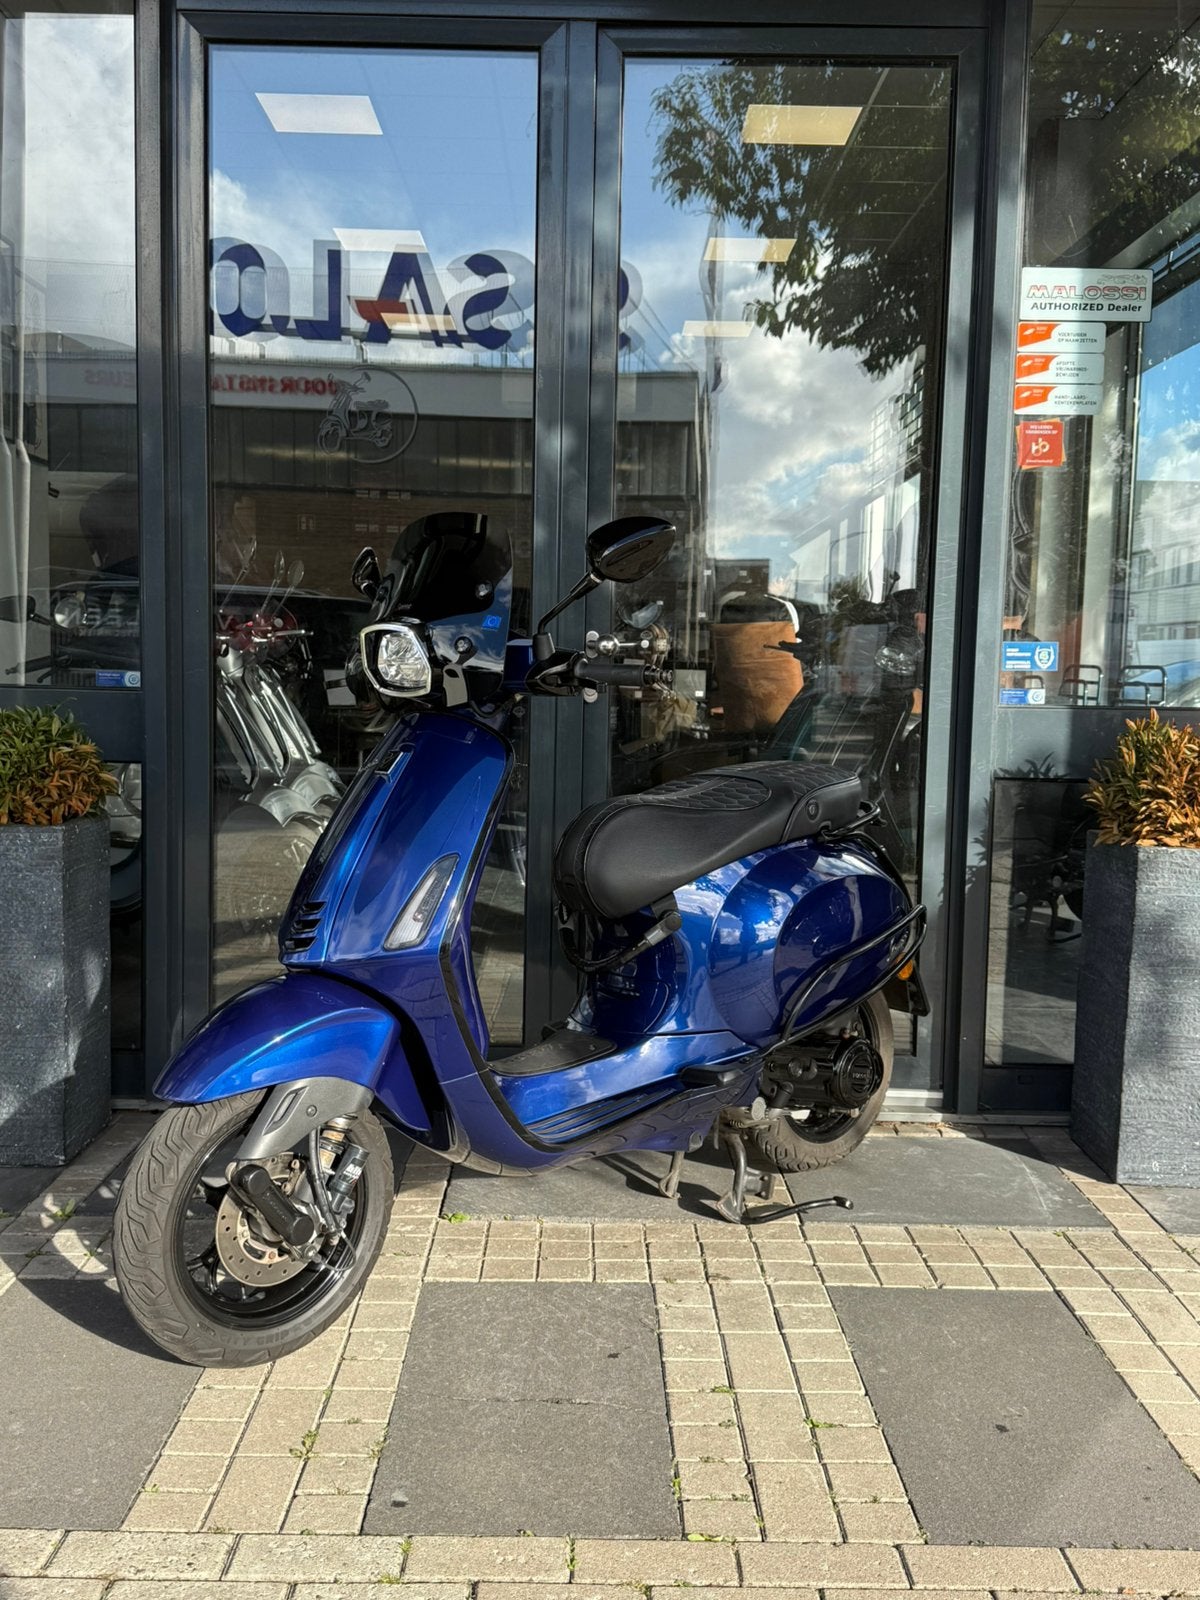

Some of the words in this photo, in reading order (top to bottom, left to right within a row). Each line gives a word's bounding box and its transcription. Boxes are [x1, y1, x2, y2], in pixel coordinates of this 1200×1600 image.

[1027, 285, 1147, 301] MALOSSI
[1030, 302, 1104, 311] AUTHORIZED
[1107, 303, 1142, 312] Dealer
